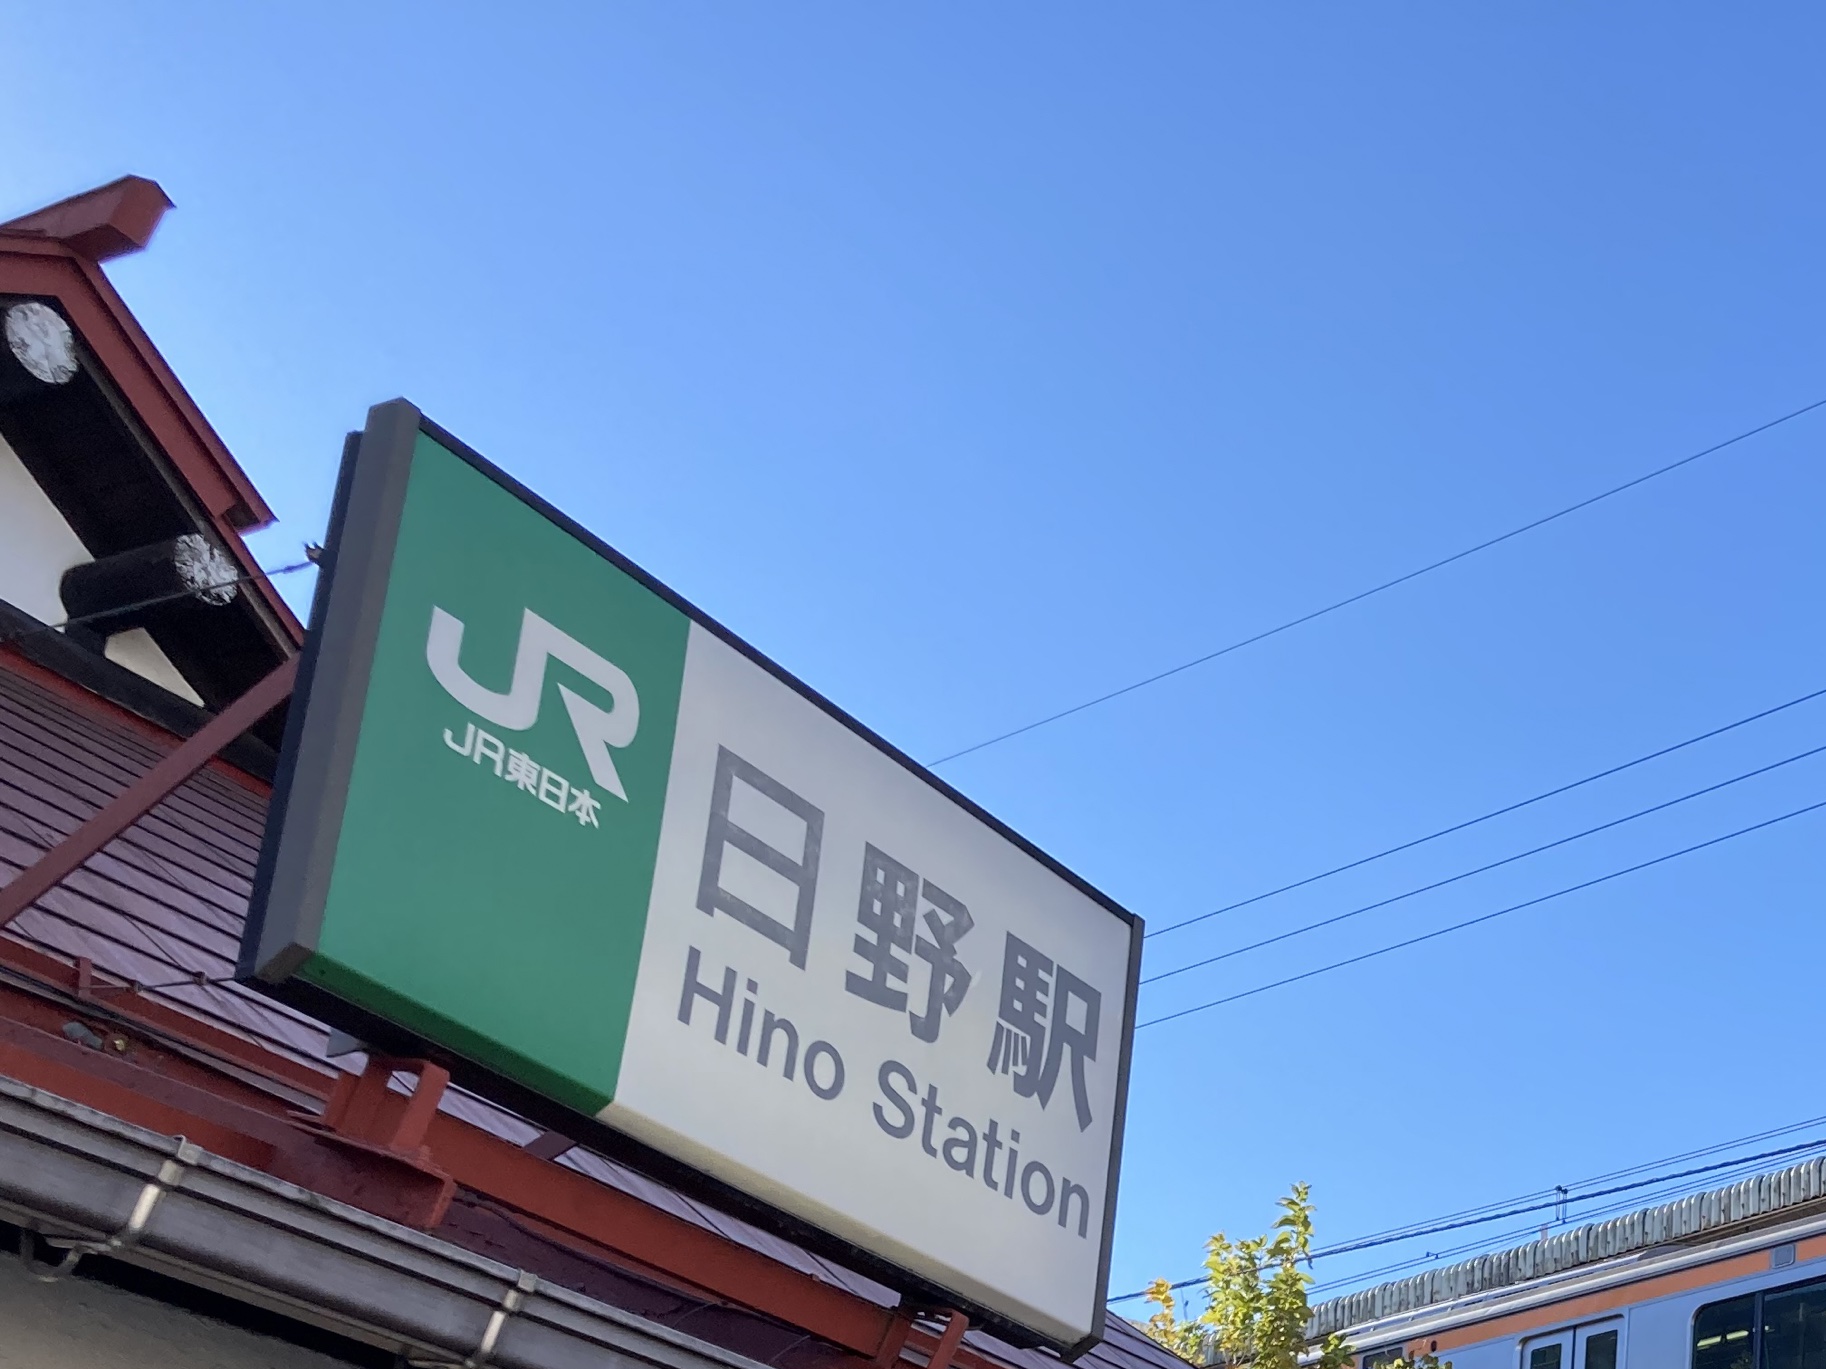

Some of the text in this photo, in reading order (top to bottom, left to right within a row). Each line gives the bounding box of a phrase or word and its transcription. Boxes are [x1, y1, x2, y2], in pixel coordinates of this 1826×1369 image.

[425, 606, 641, 803] JR
[443, 723, 601, 828] JR東日本
[695, 744, 1102, 1132] 日野駅
[677, 948, 1091, 1239] Hino Station
